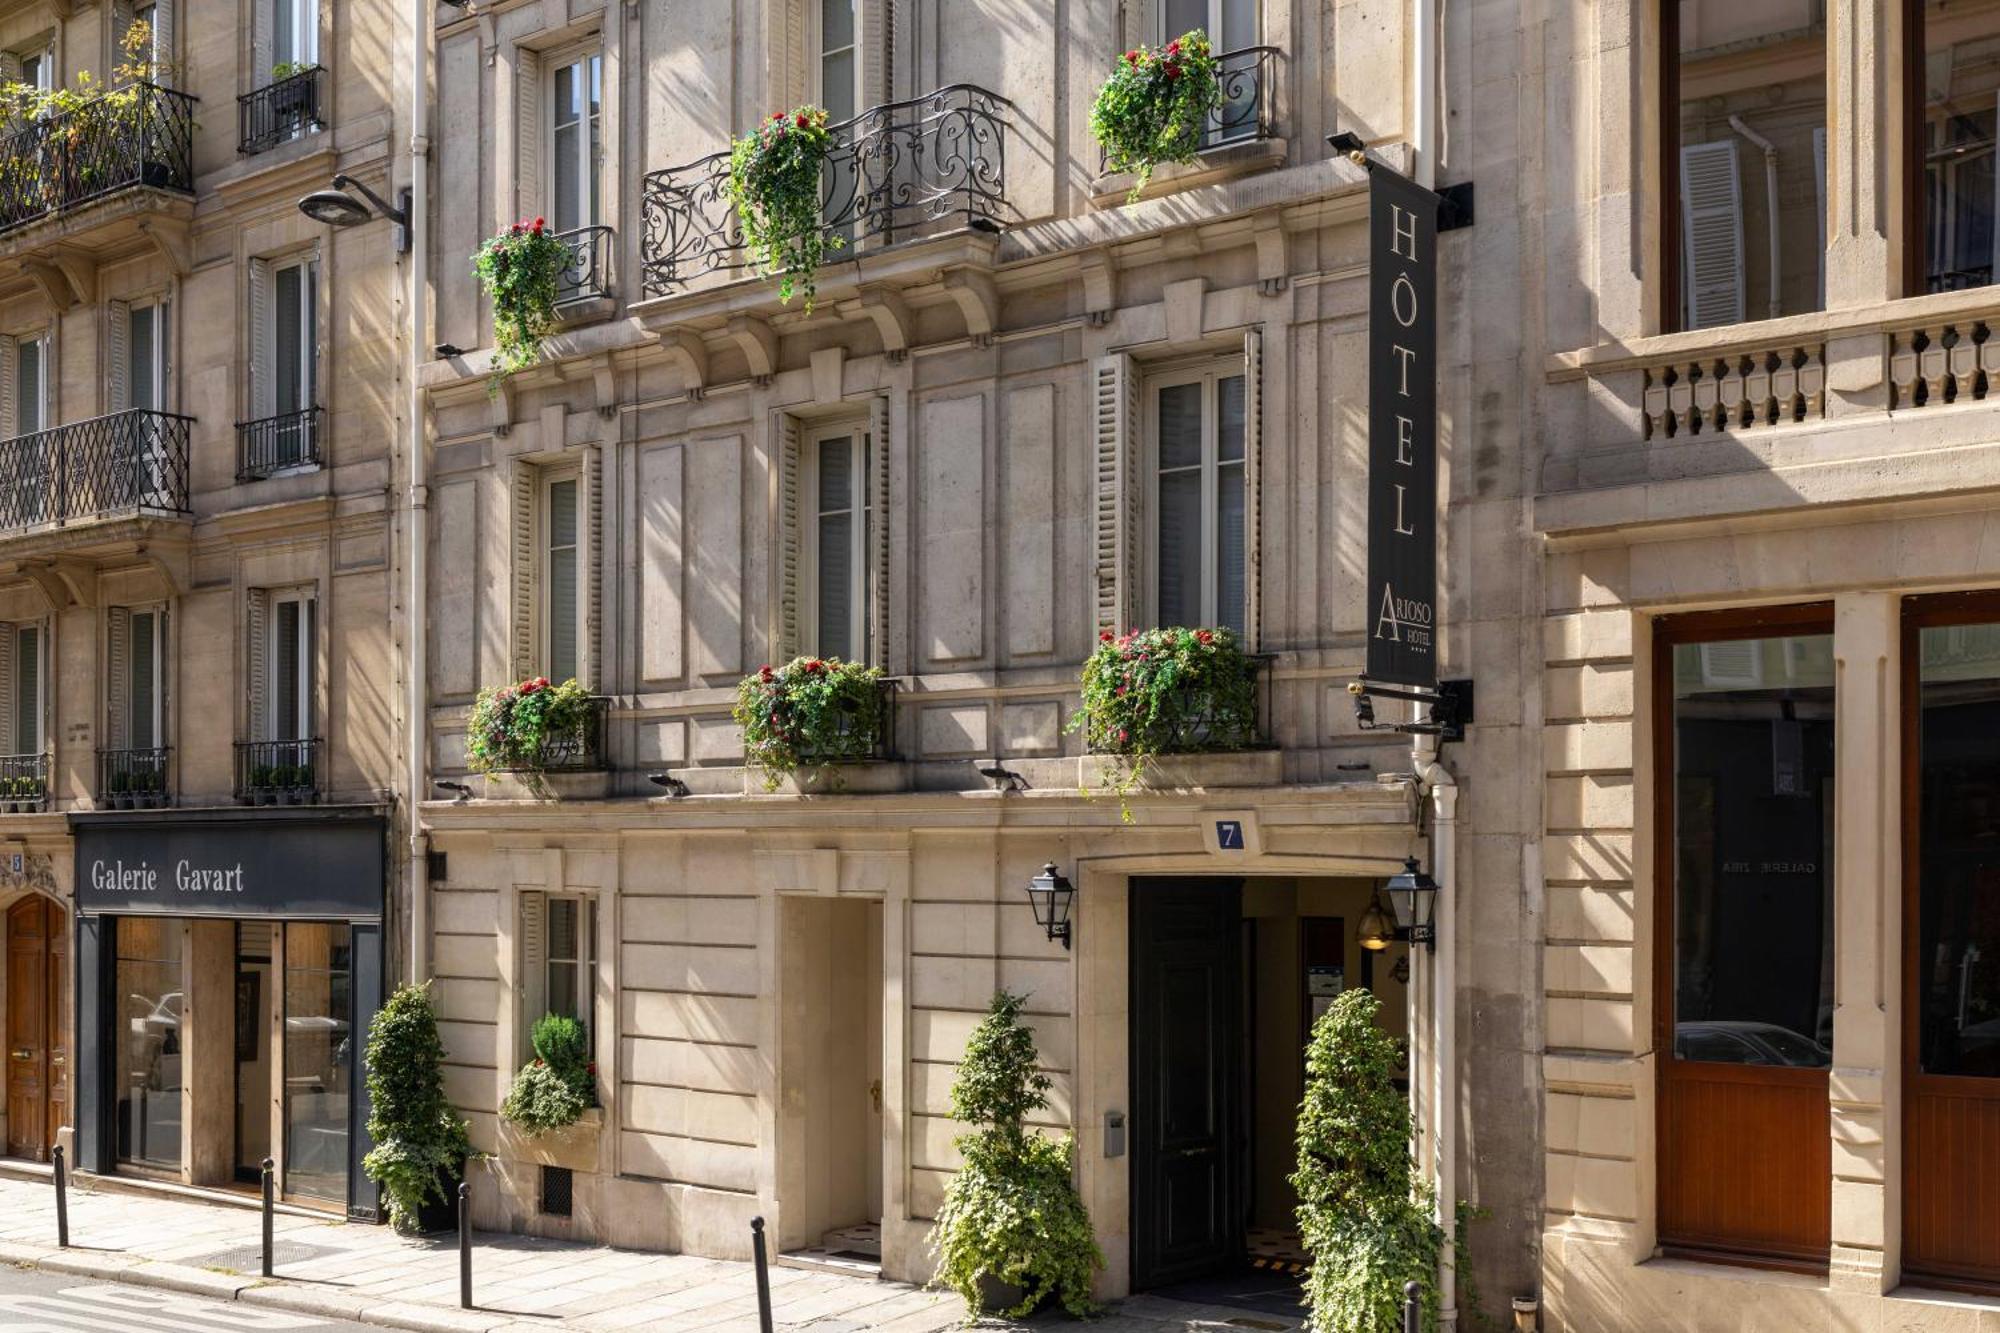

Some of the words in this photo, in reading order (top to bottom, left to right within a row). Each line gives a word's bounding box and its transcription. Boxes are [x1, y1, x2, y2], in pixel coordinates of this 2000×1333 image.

[1389, 203, 1417, 537] HÔTEL
[1222, 824, 1235, 846] 7
[91, 859, 158, 891] Galerie
[176, 859, 244, 892] Gavart
